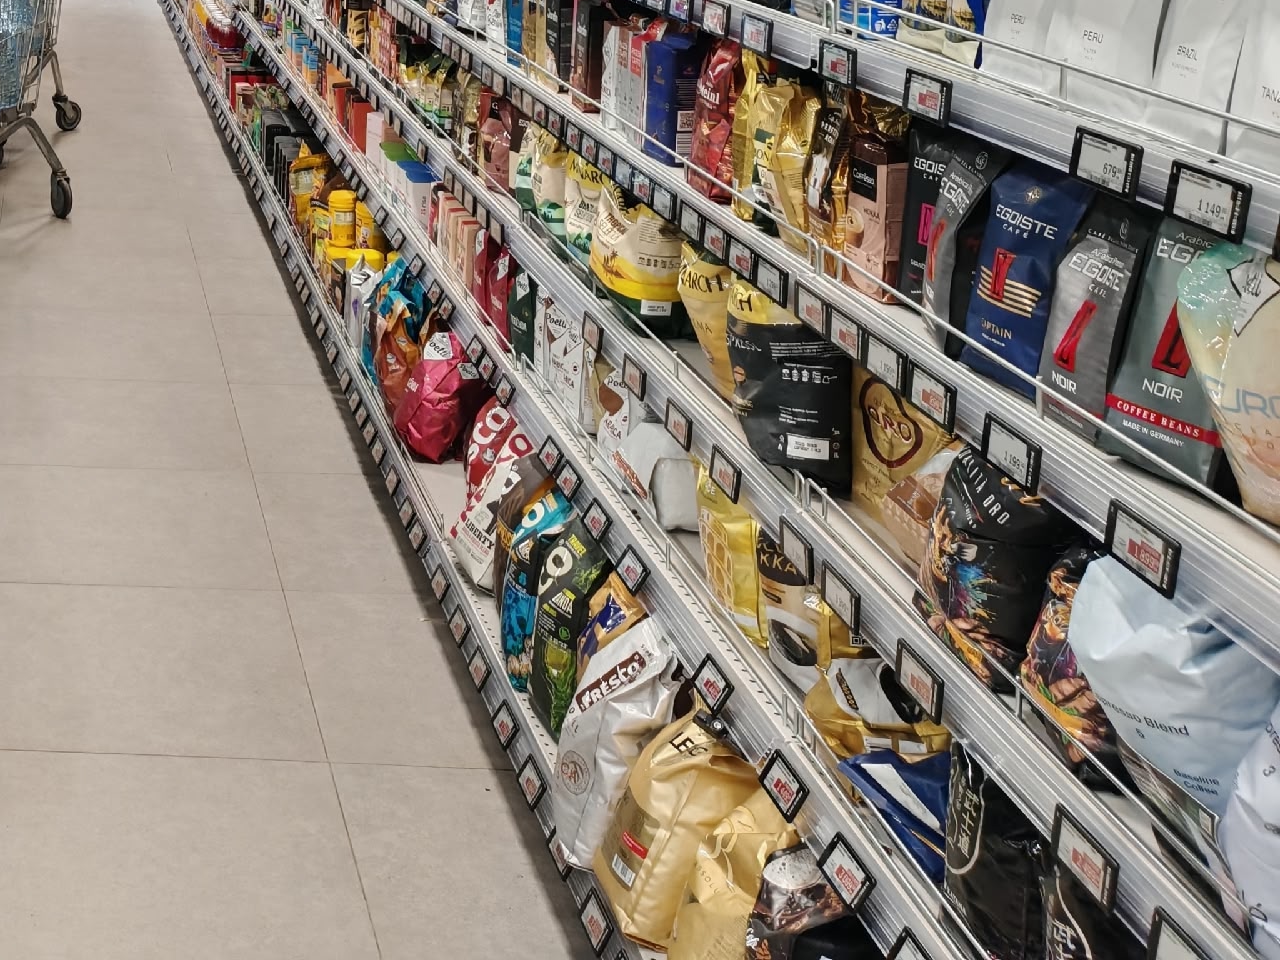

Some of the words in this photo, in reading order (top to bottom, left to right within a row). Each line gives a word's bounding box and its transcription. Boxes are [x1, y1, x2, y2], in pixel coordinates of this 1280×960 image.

[1082, 29, 1104, 44] PERU
[1177, 45, 1198, 61] BRAZIL
[913, 156, 946, 176] EGOIS
[995, 203, 1059, 240] EGOISTE
[1176, 231, 1217, 249] Arabic
[1051, 370, 1077, 395] NOIR
[1142, 377, 1183, 403] NOIR
[869, 407, 913, 442] ORO
[1116, 400, 1157, 423] COFFEE
[1160, 415, 1200, 438] BEANS
[1143, 716, 1190, 737] Blend
